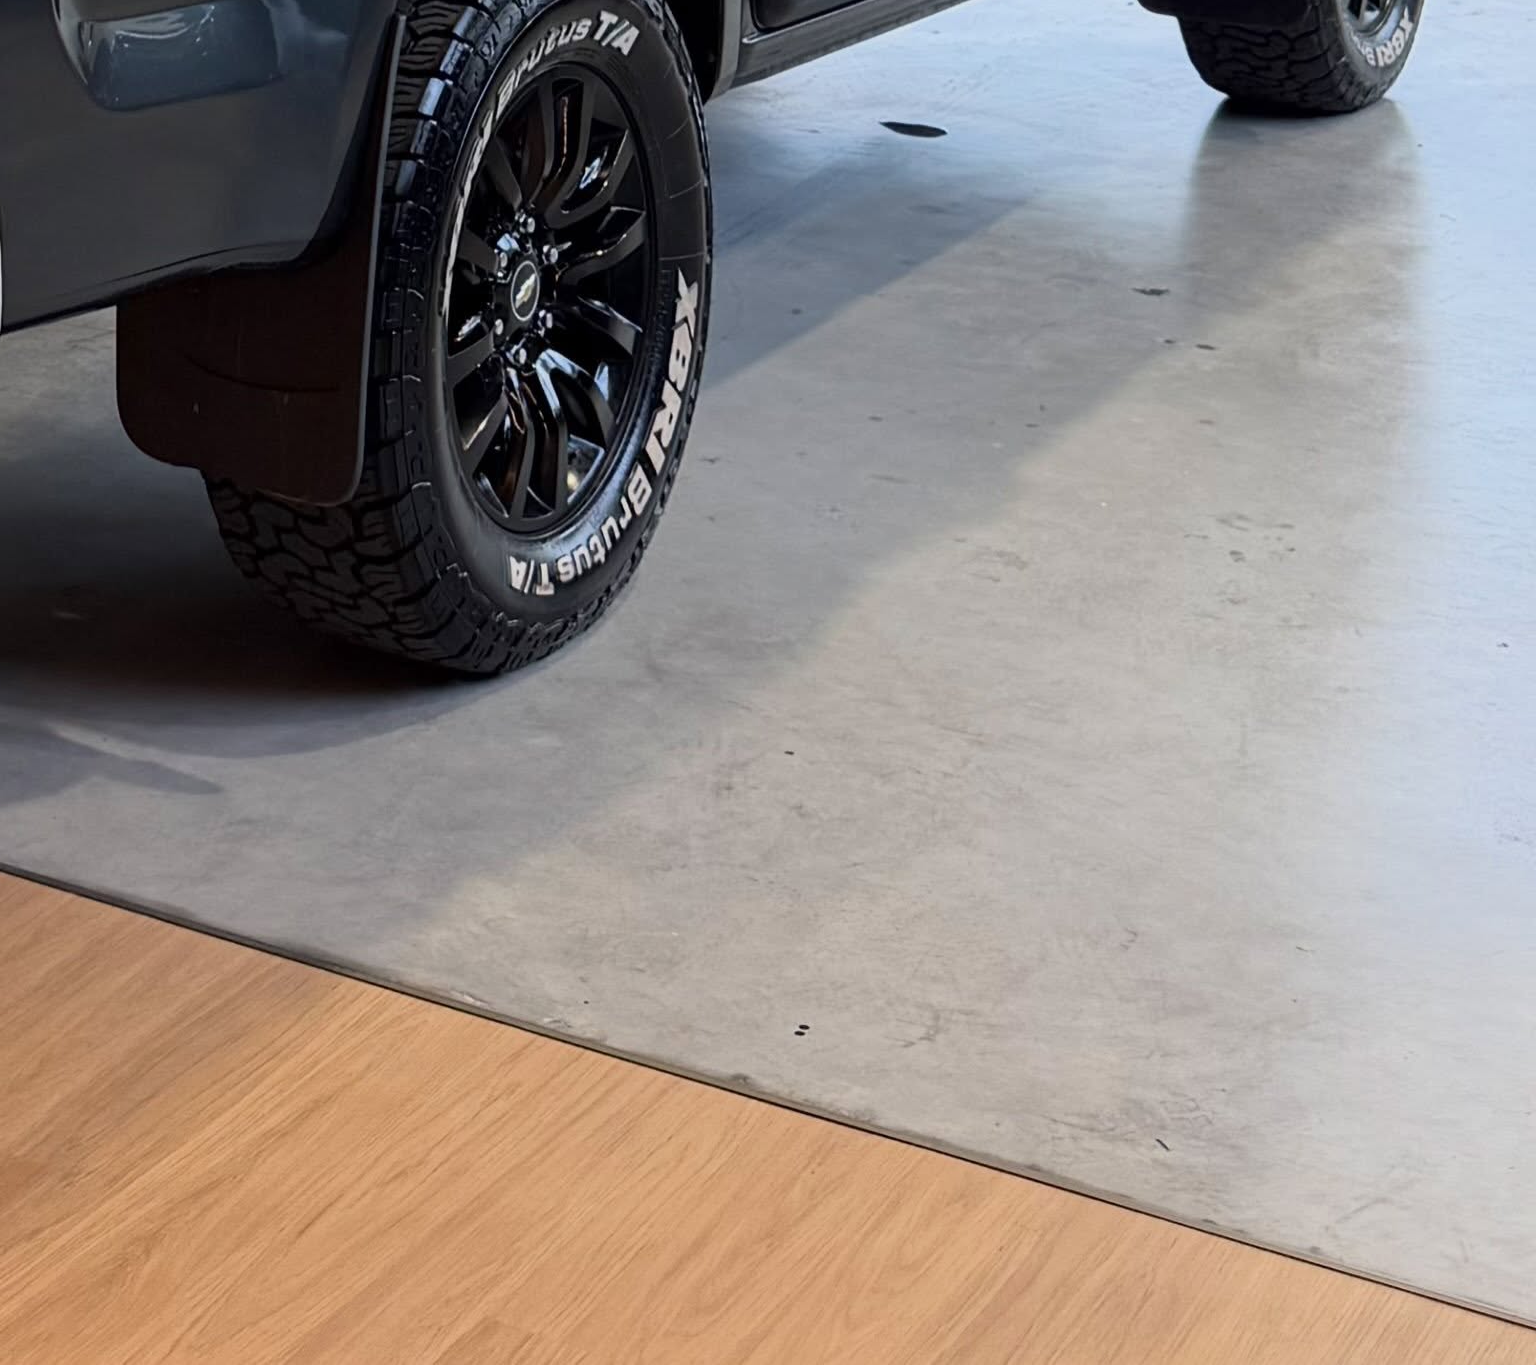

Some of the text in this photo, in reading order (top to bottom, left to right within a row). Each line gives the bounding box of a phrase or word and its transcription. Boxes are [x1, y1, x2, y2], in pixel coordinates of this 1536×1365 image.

[593, 10, 641, 56] T/A
[509, 267, 699, 596] XBRI Brutus T/A
